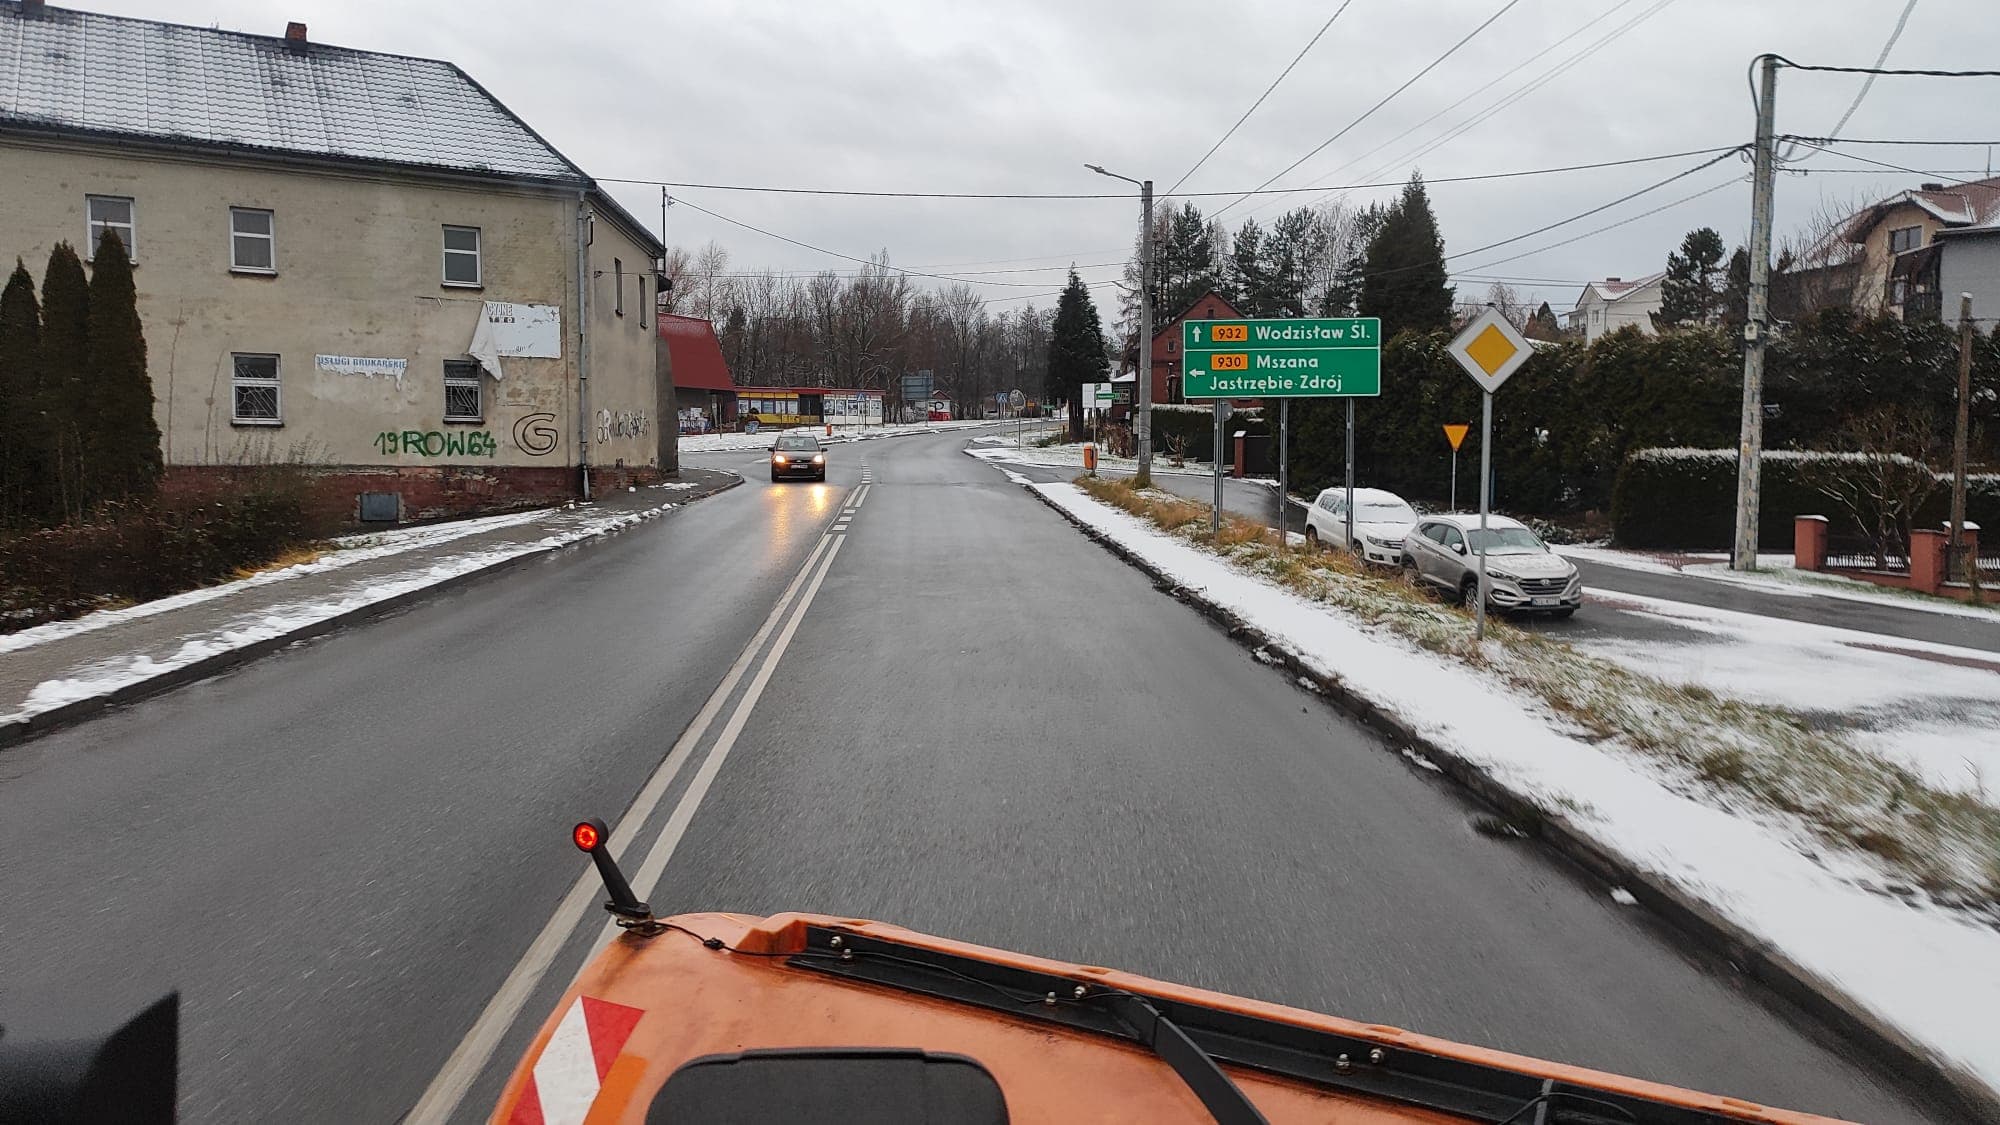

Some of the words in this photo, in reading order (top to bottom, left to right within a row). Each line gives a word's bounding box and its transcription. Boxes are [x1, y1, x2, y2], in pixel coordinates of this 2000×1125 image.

[1218, 327, 1242, 339] 932
[1255, 325, 1344, 340] Wodzisław
[1350, 320, 1371, 339] Śl.
[1217, 356, 1242, 368] 930
[1256, 354, 1319, 368] Mszana
[1209, 374, 1343, 393] Jastrzębie-Zdrój
[512, 412, 559, 456] G
